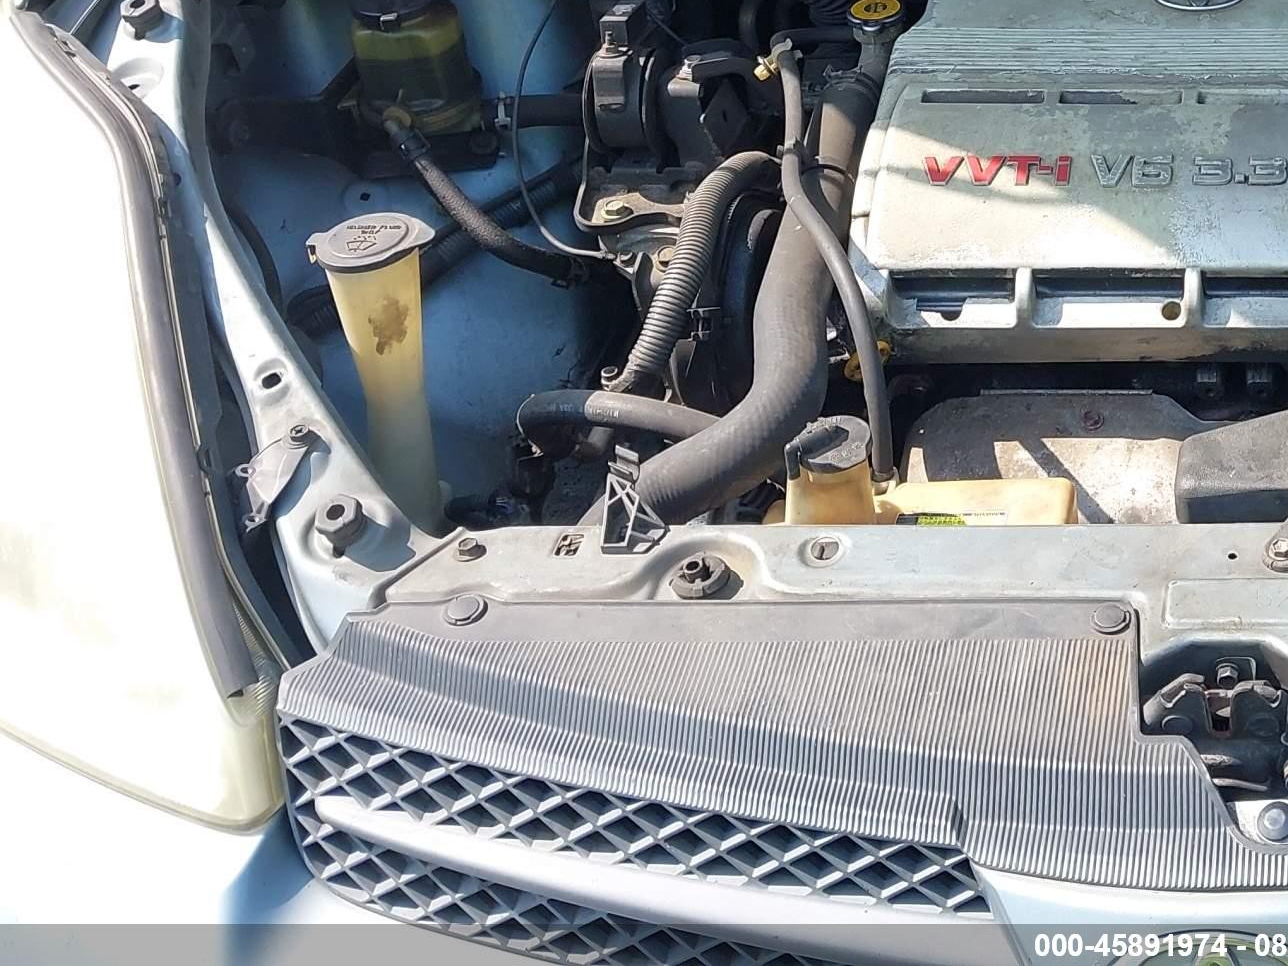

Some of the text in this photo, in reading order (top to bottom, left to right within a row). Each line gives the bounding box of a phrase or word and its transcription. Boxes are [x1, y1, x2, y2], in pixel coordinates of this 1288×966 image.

[924, 154, 1288, 188] VVT-i V6 3.3
